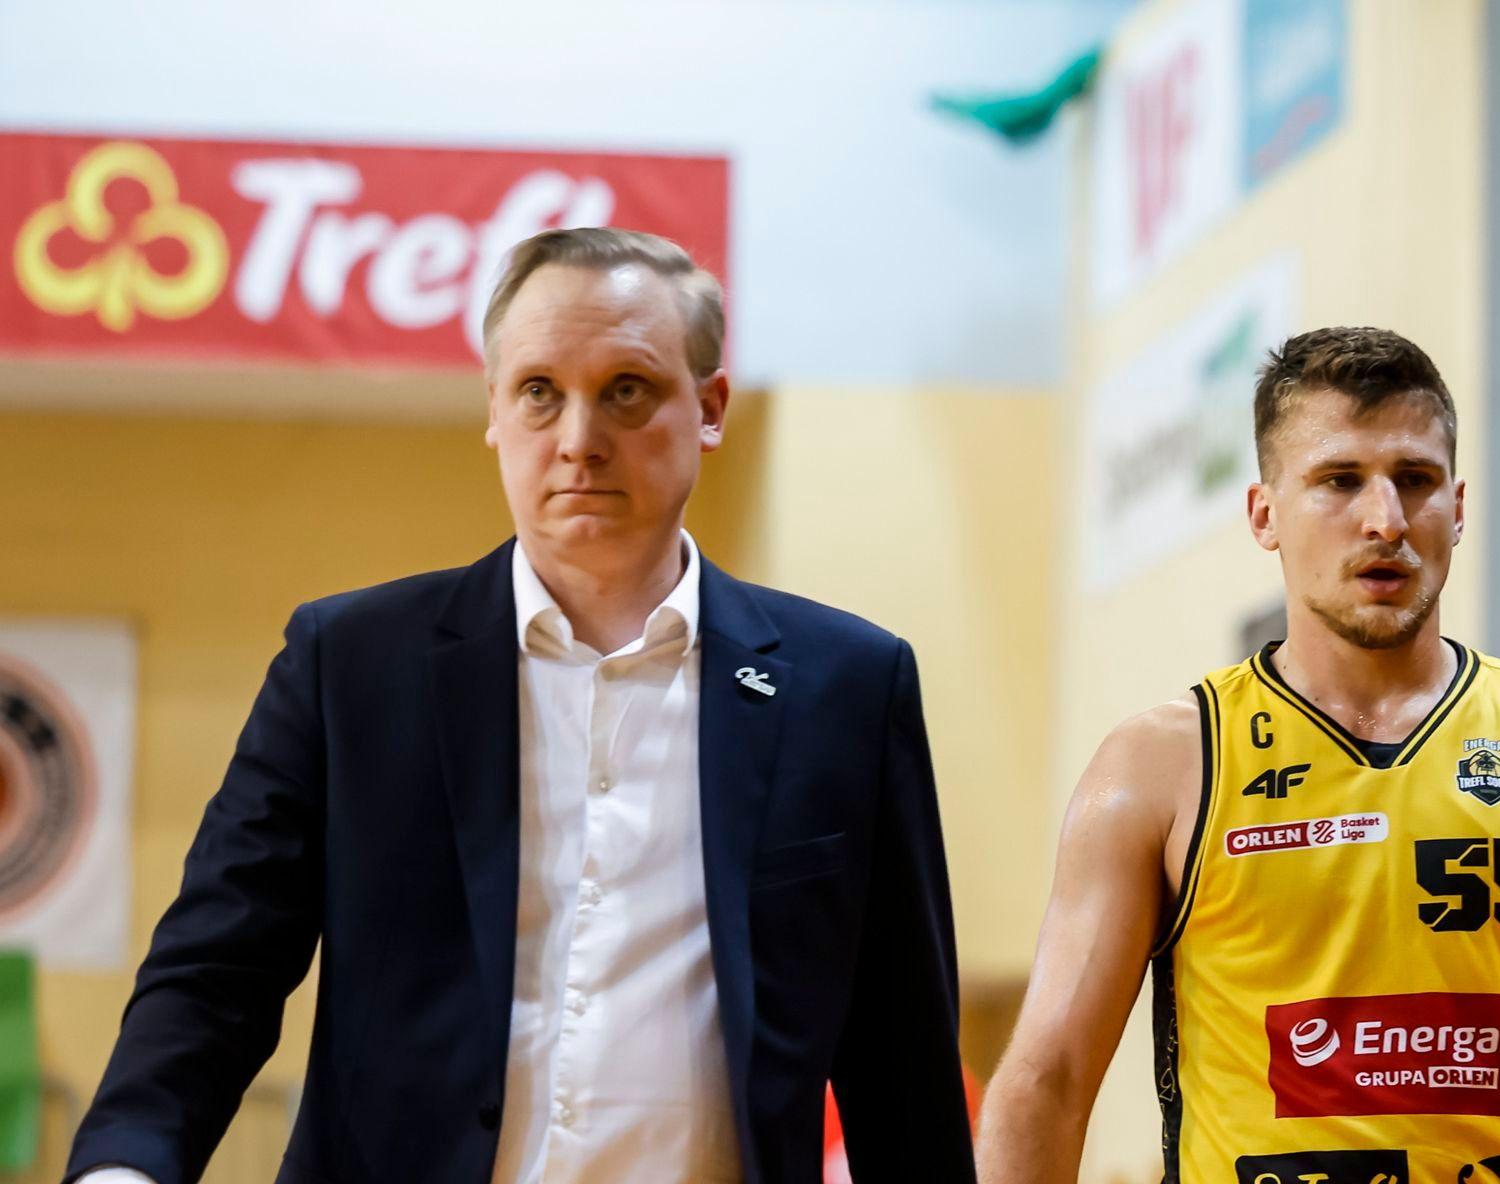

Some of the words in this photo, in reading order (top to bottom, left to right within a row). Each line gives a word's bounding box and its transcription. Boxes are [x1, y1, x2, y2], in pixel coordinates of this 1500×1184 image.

[1251, 712, 1274, 749] C
[1242, 763, 1312, 799] 4F
[1458, 777, 1486, 789] TREFL
[1232, 828, 1302, 849] ORLEN
[1341, 817, 1380, 828] Basket
[1341, 830, 1366, 841] Liga
[1354, 1021, 1500, 1062] Energa
[1355, 1070, 1426, 1087] GRUPA
[1432, 1069, 1495, 1086] ORLEN
